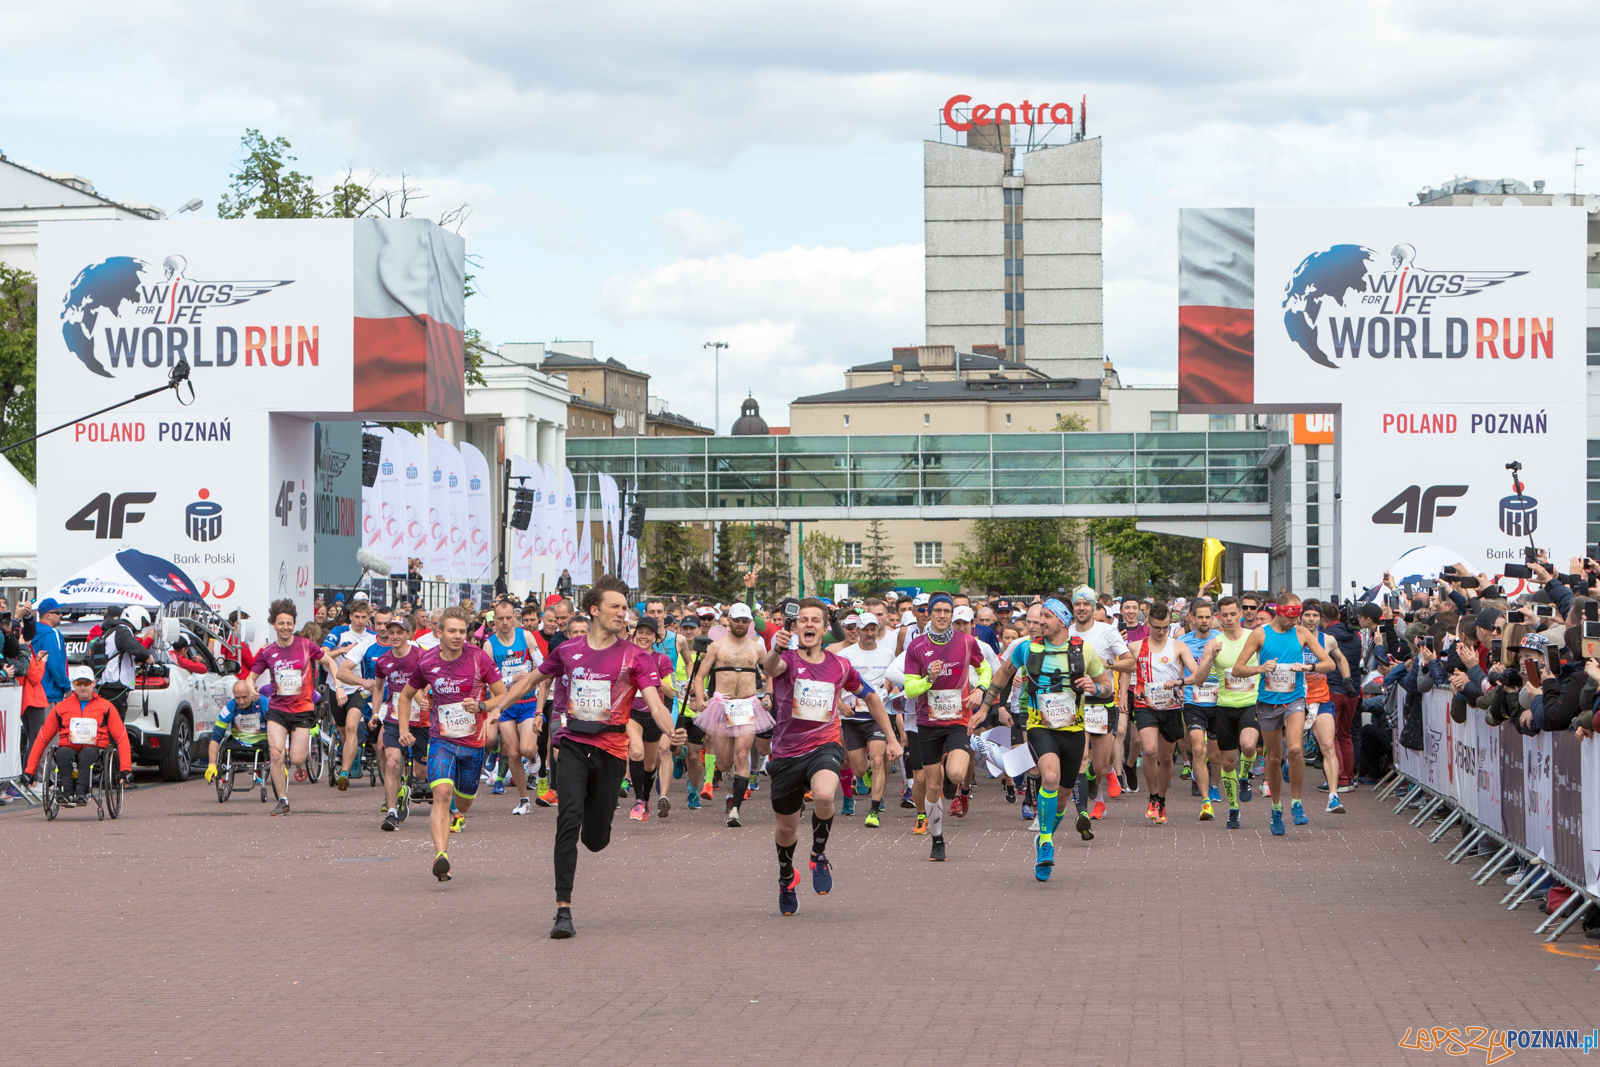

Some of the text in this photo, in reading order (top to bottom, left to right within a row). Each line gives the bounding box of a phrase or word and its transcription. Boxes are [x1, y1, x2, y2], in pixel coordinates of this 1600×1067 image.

[943, 94, 1073, 132] Centra
[140, 280, 233, 303] WINGS
[1368, 271, 1464, 294] WINGS
[135, 306, 206, 324] FOR LIFE
[1361, 295, 1436, 315] FOR LIFE
[104, 325, 319, 368] WORLD RUN
[1328, 316, 1554, 360] WORLD RUN
[75, 417, 231, 443] POLAND POZNAŃ
[1382, 409, 1547, 434] POLAND POZNAŃ
[65, 492, 157, 540] 4F
[314, 493, 355, 538] WORLD RUN
[1371, 484, 1469, 533] 4F
[173, 553, 235, 564] Bank Polski
[1486, 548, 1515, 560] Bank
[72, 586, 144, 601] WORLD RUN
[64, 642, 87, 657] ĘKU
[575, 698, 603, 708] 15113
[799, 697, 828, 708] 88047
[1045, 707, 1070, 717] 18283
